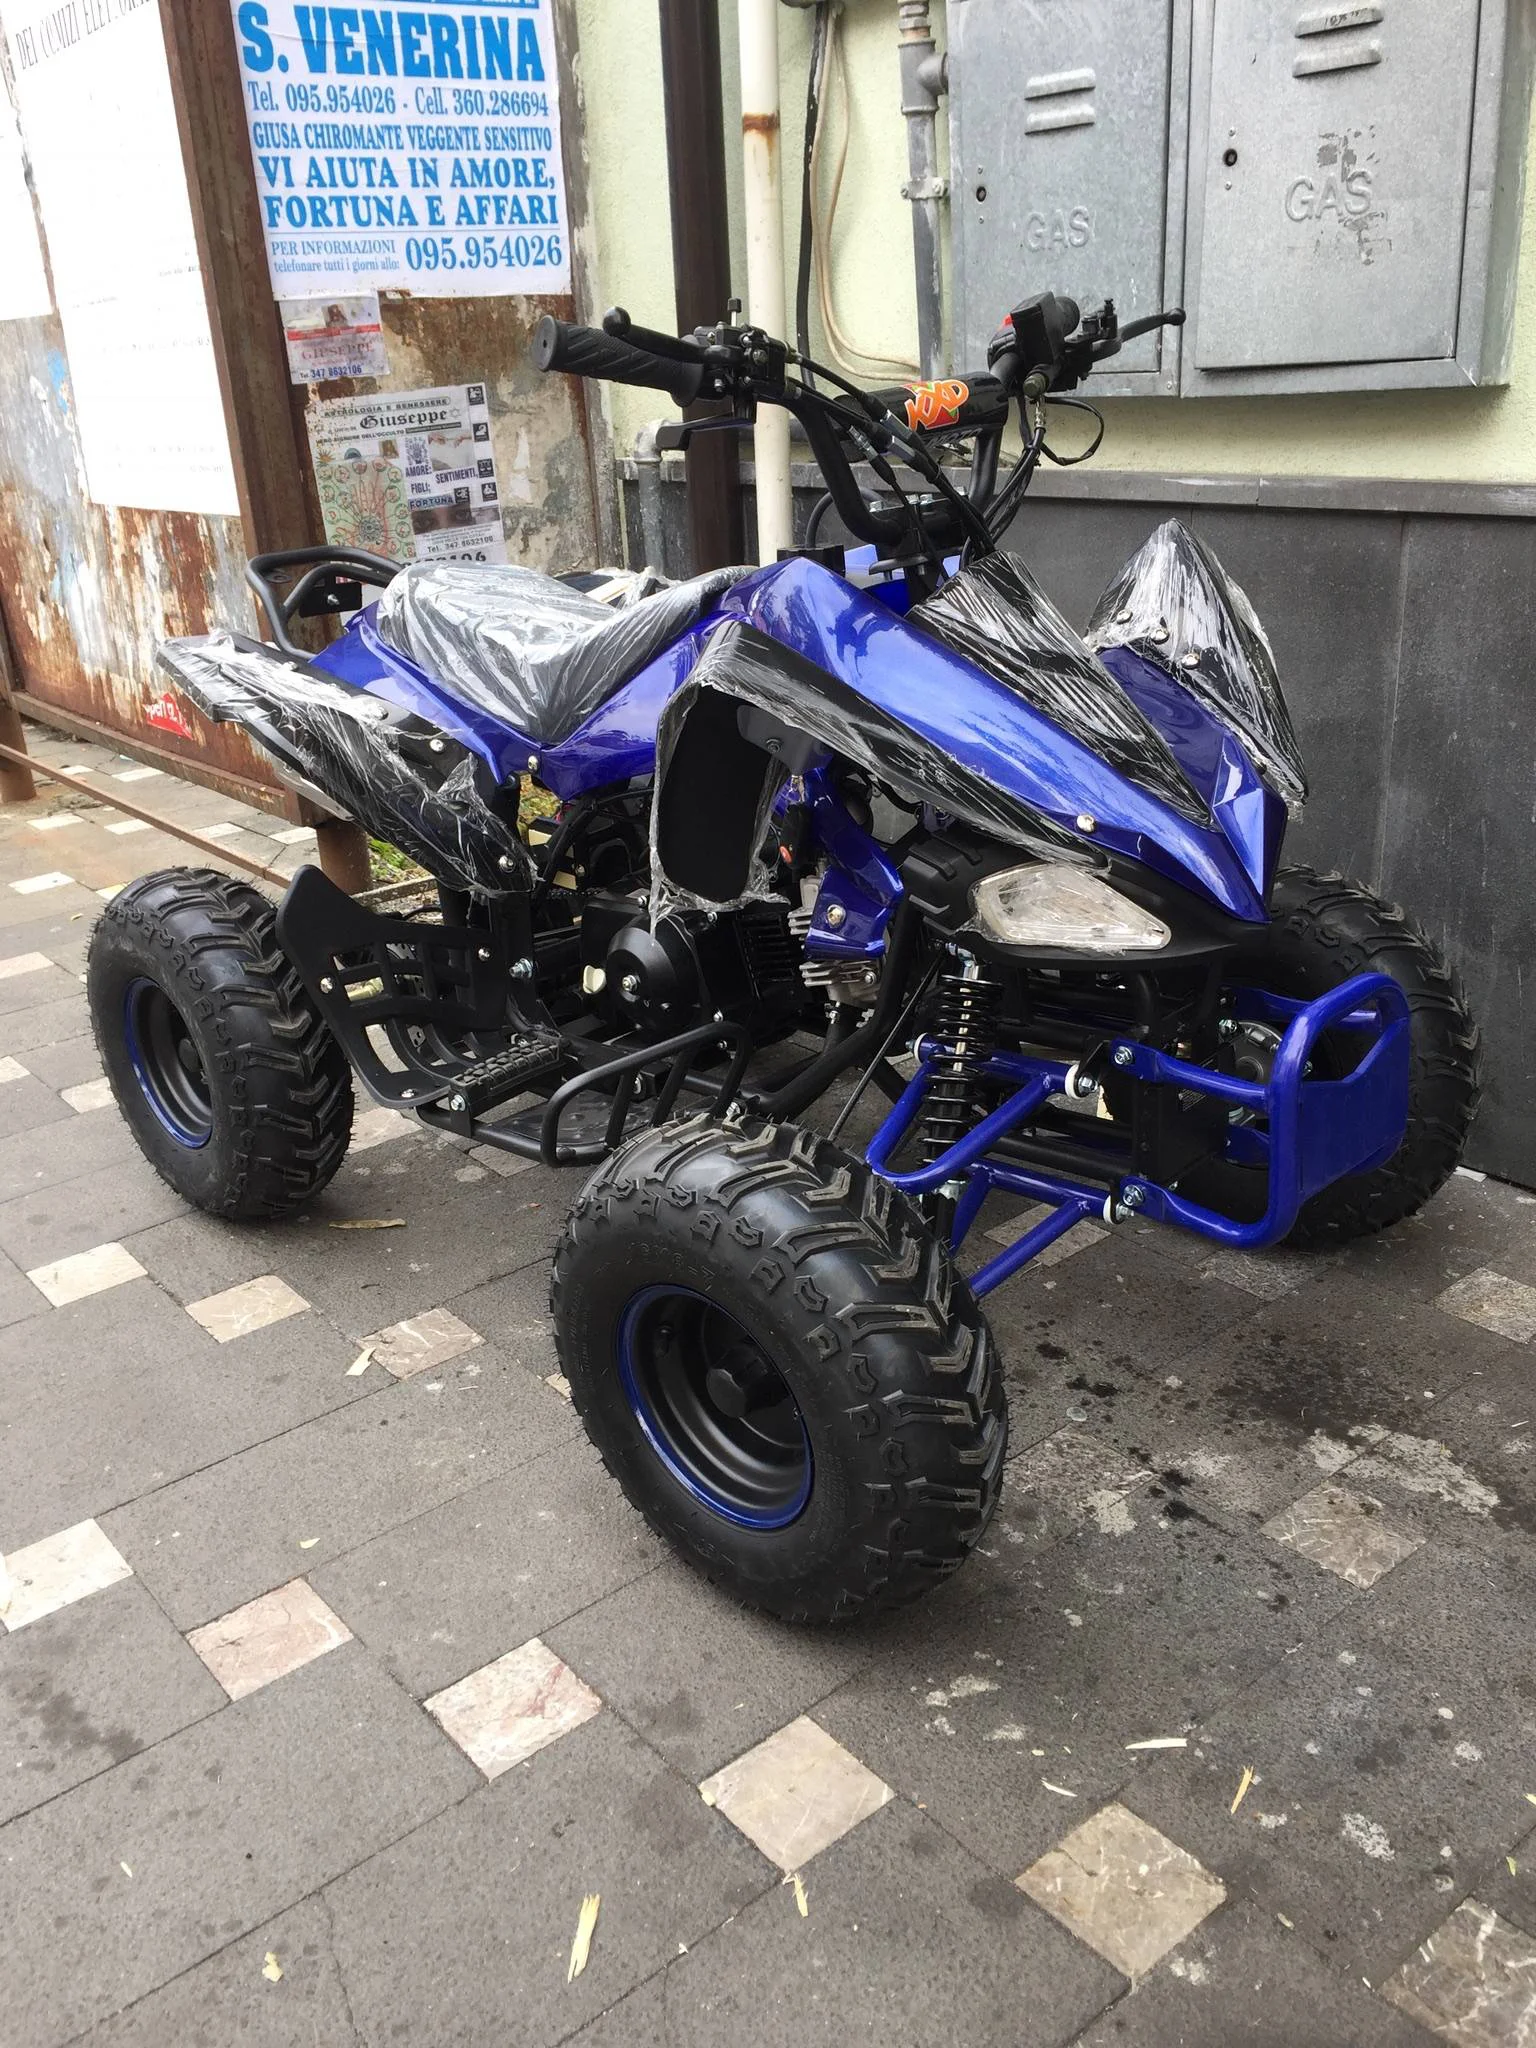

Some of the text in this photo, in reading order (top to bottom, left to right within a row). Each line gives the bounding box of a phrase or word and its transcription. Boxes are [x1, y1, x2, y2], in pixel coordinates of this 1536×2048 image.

[16, 26, 38, 70] DEI
[238, 2, 545, 82] S. VENERINA
[248, 80, 279, 111] Tel.
[285, 83, 396, 114] 095.954026
[415, 86, 448, 115] Cell.
[453, 88, 549, 117] 360.286694
[252, 122, 552, 151] GIUSA CHIROMANTE VEGGENTE SENSITIVO
[258, 156, 556, 190] VI AIUTA IN AMORE,
[263, 195, 559, 228] FORTUNA E AFFARI
[1285, 169, 1372, 222] GAS
[1025, 206, 1090, 250] GAS
[271, 239, 396, 256] PER INFORMAZIONI
[405, 235, 563, 271] 095.954026
[274, 260, 321, 274] telefonare
[323, 260, 345, 272] tutti
[351, 260, 379, 275] giorni
[310, 368, 325, 379] 347
[360, 410, 447, 429] Giuseppe
[904, 379, 969, 432] KXD
[409, 496, 453, 509] FORTUNA
